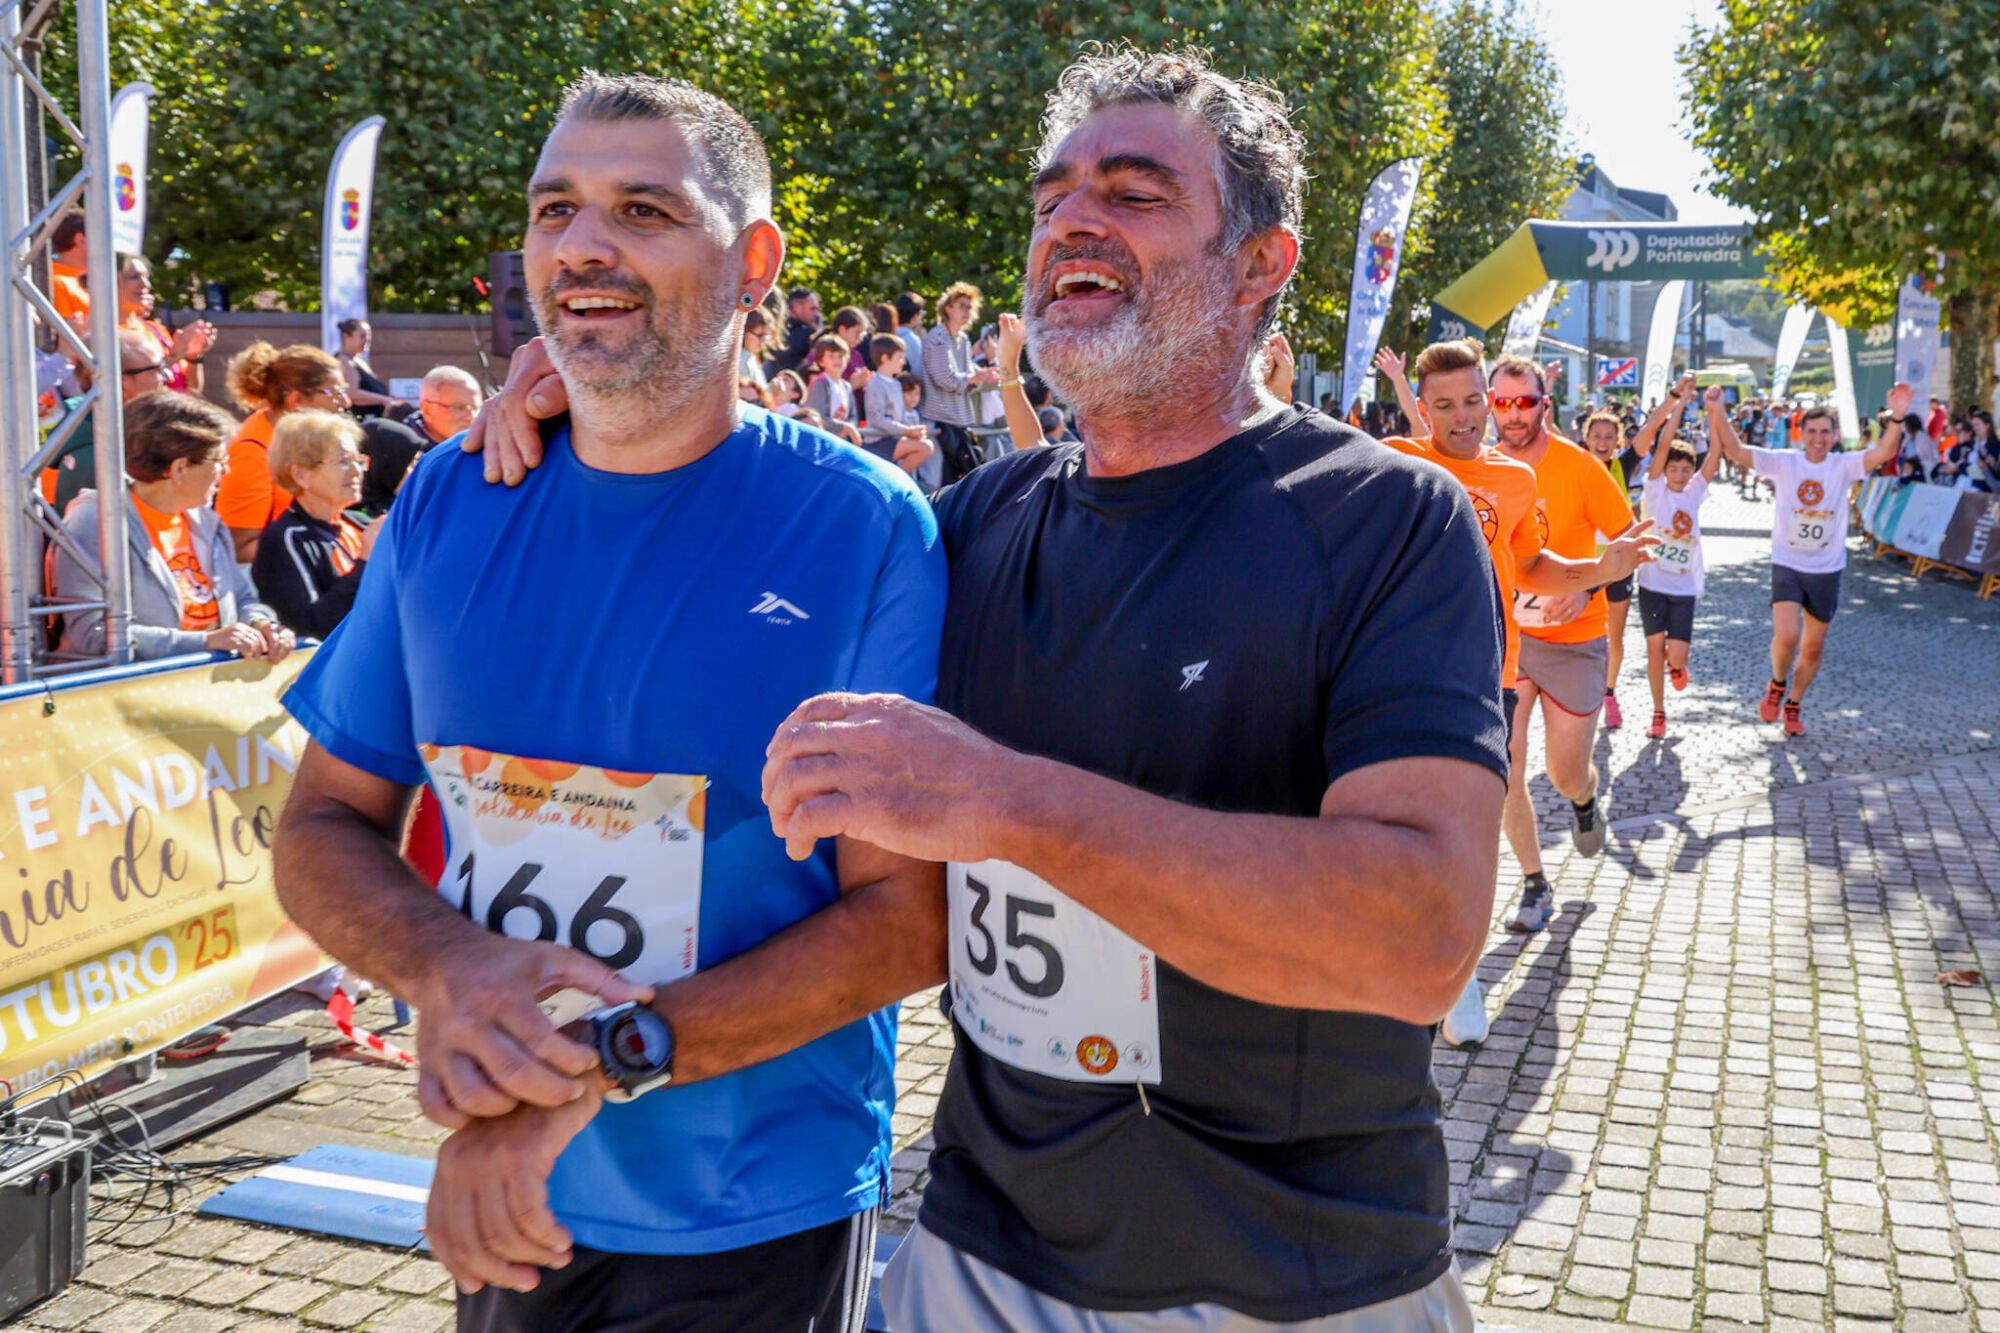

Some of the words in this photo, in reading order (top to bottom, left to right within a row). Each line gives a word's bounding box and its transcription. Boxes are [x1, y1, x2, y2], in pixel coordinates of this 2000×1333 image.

[1647, 232, 1741, 250] Deputación
[1647, 249, 1741, 263] Pontevedra
[1798, 523, 1823, 540] 30
[1654, 543, 1689, 564] 425
[475, 777, 545, 799] CARREIRA
[551, 789, 560, 801] E
[563, 792, 637, 811] ANDAINA
[14, 785, 58, 851] E
[110, 806, 188, 901] de
[455, 851, 644, 970] 166
[966, 872, 1064, 998] 35
[0, 937, 72, 972] NFERMIDADES
[0, 935, 177, 1054] TUBRO
